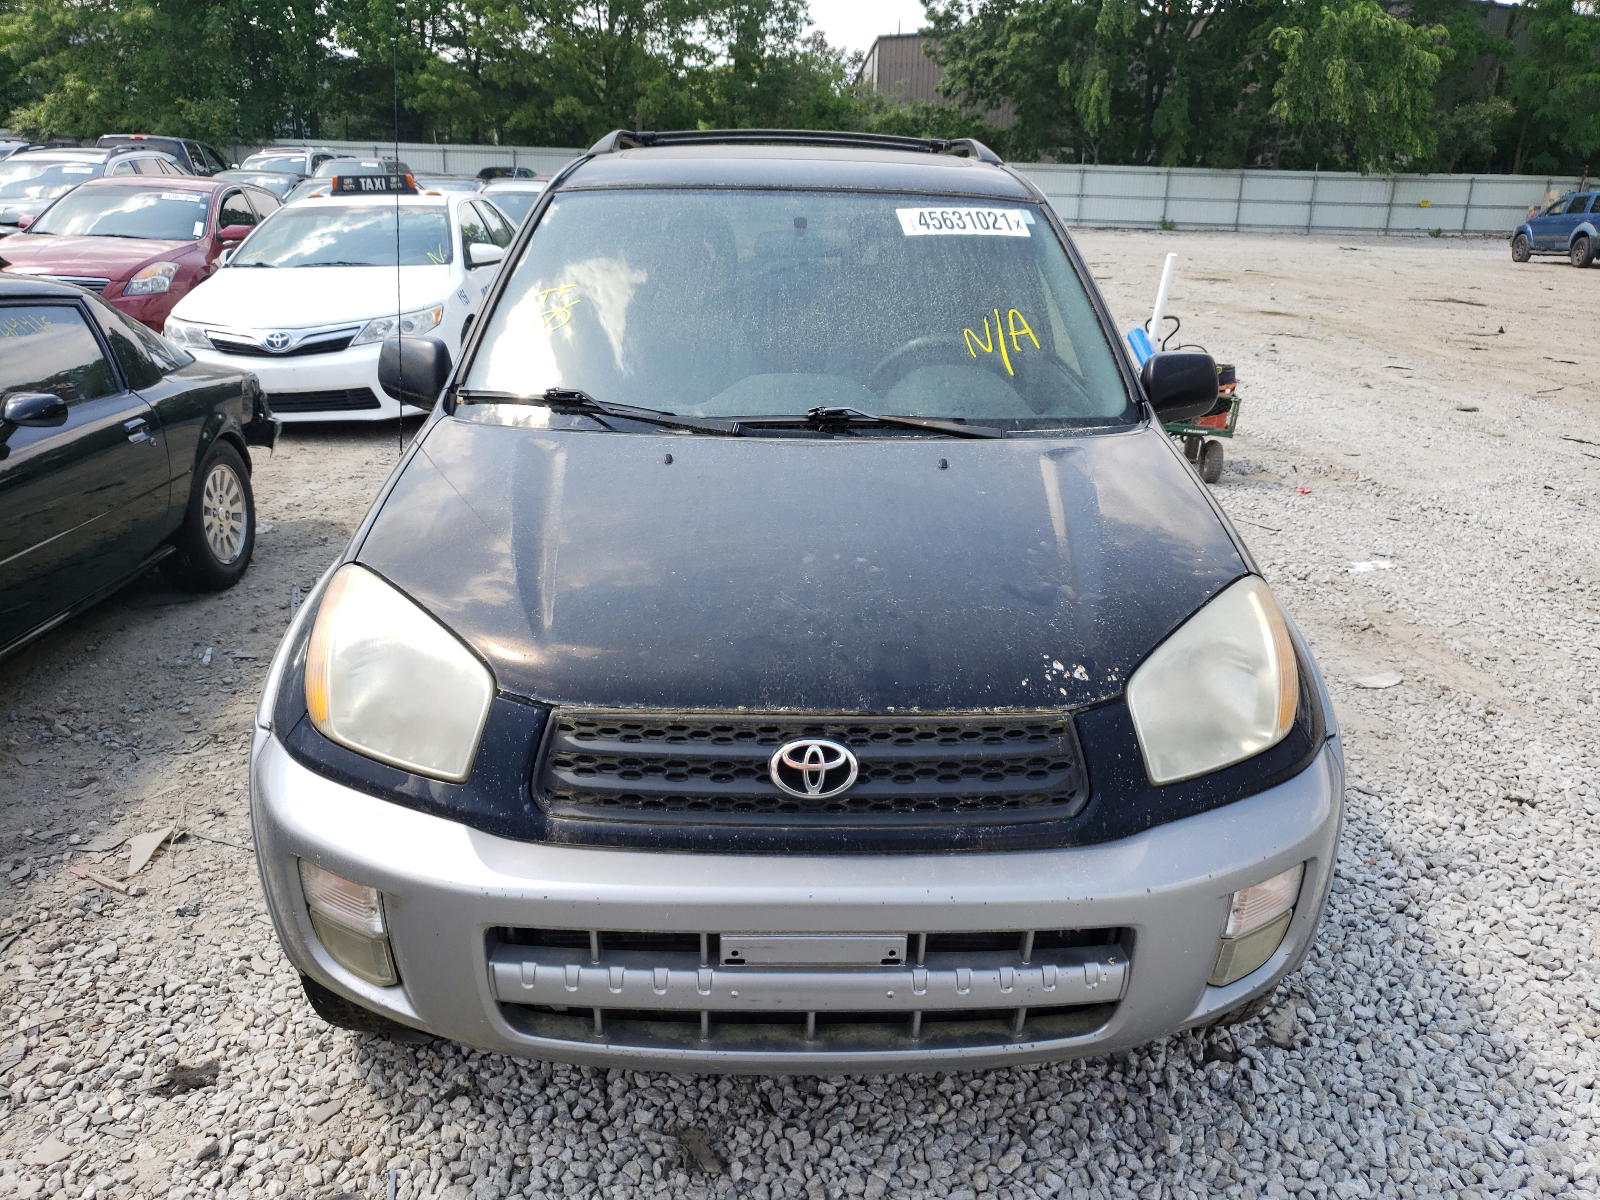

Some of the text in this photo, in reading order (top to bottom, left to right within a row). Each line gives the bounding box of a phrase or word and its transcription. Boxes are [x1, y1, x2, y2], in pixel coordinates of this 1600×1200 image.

[359, 177, 386, 191] TAXI
[918, 210, 1013, 232] 45631021
[963, 308, 1041, 377] N/A
